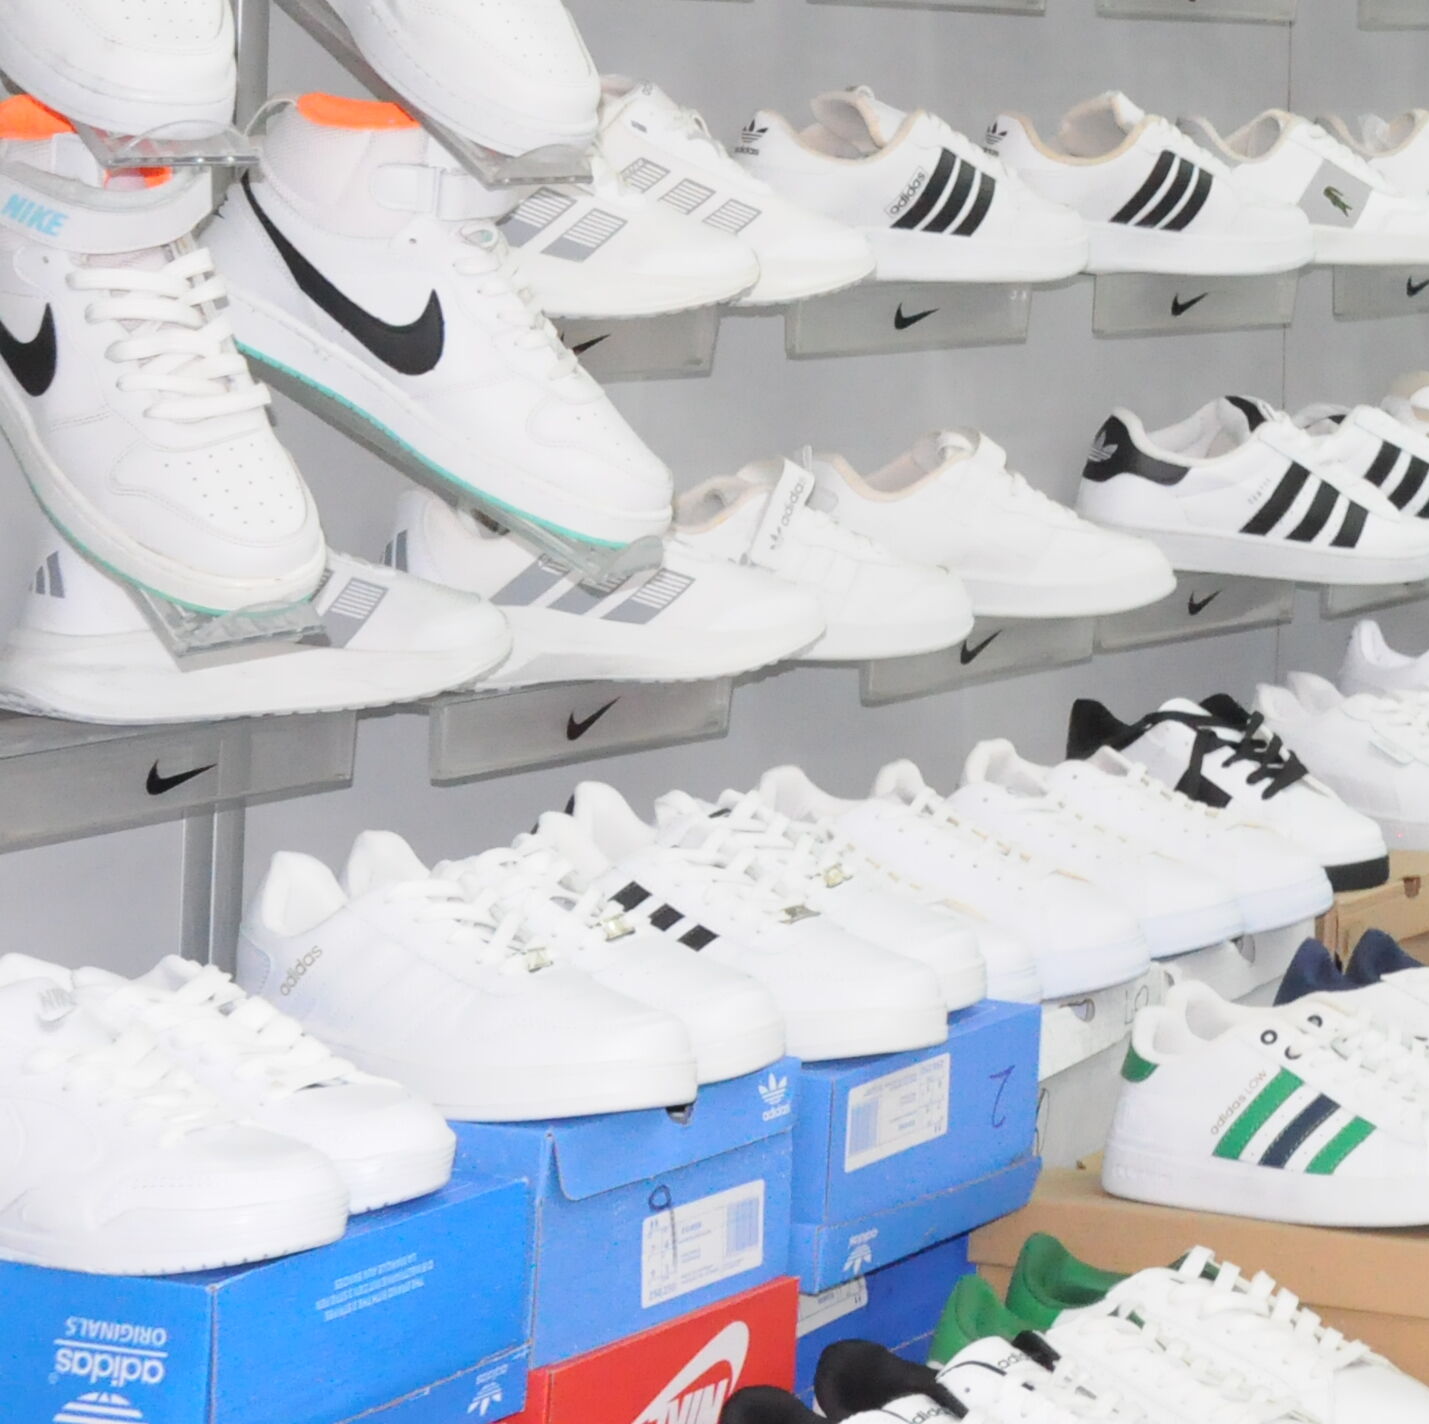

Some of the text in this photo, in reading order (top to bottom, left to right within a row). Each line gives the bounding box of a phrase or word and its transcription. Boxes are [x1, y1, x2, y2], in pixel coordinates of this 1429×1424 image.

[0, 192, 70, 237] NIKE
[888, 170, 928, 217] adidas
[279, 944, 323, 997] adidas
[1210, 1094, 1247, 1136] adidas
[64, 1315, 167, 1347] ORIGINALS
[55, 1347, 165, 1388] adidas
